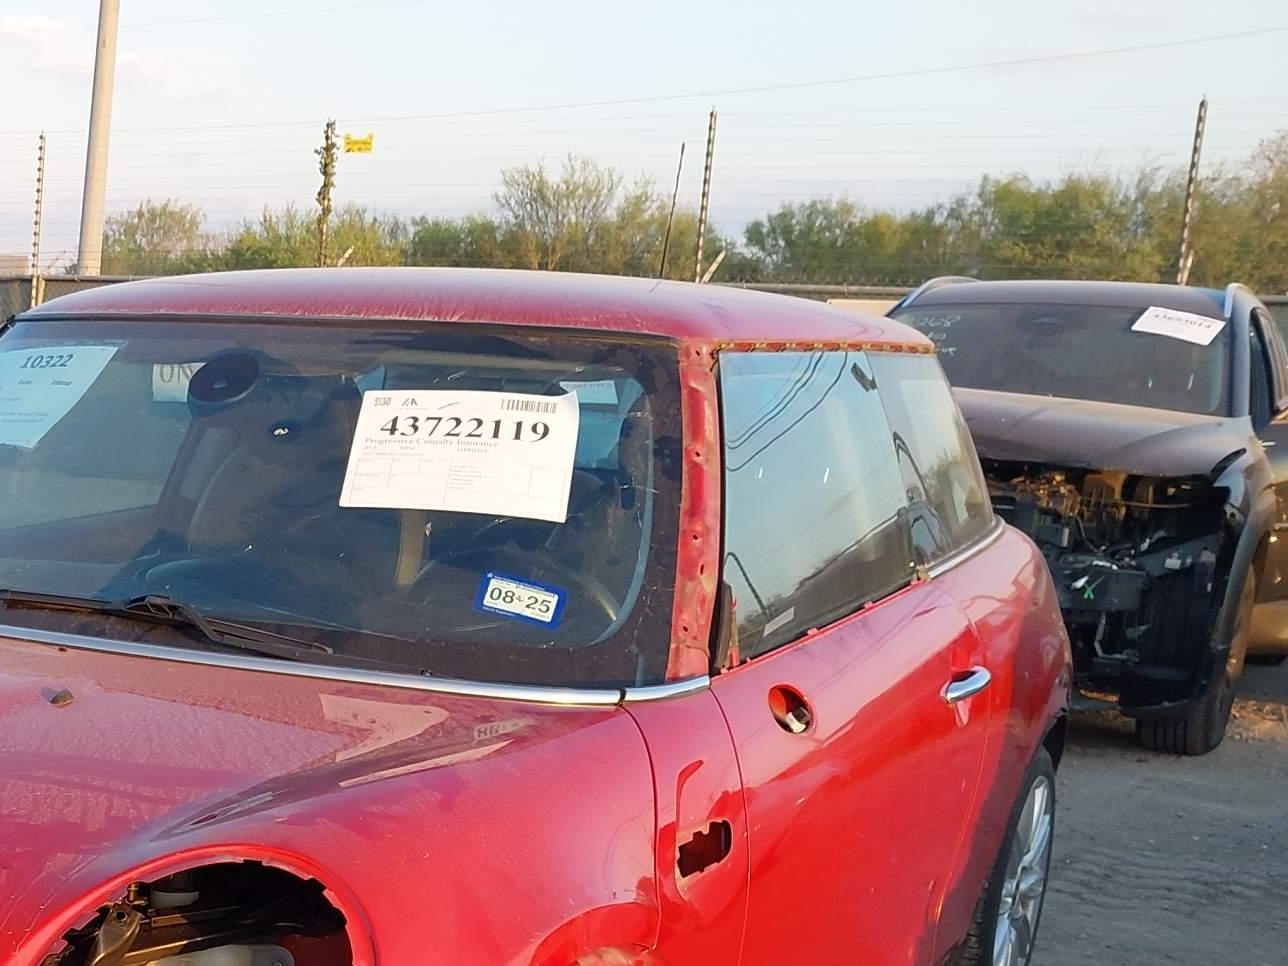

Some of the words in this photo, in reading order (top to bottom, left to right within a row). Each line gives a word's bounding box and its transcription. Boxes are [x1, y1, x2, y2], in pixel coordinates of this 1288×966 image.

[19, 353, 74, 369] 10322
[380, 415, 550, 443] 43722119
[489, 587, 516, 604] 08
[524, 595, 552, 613] 25
